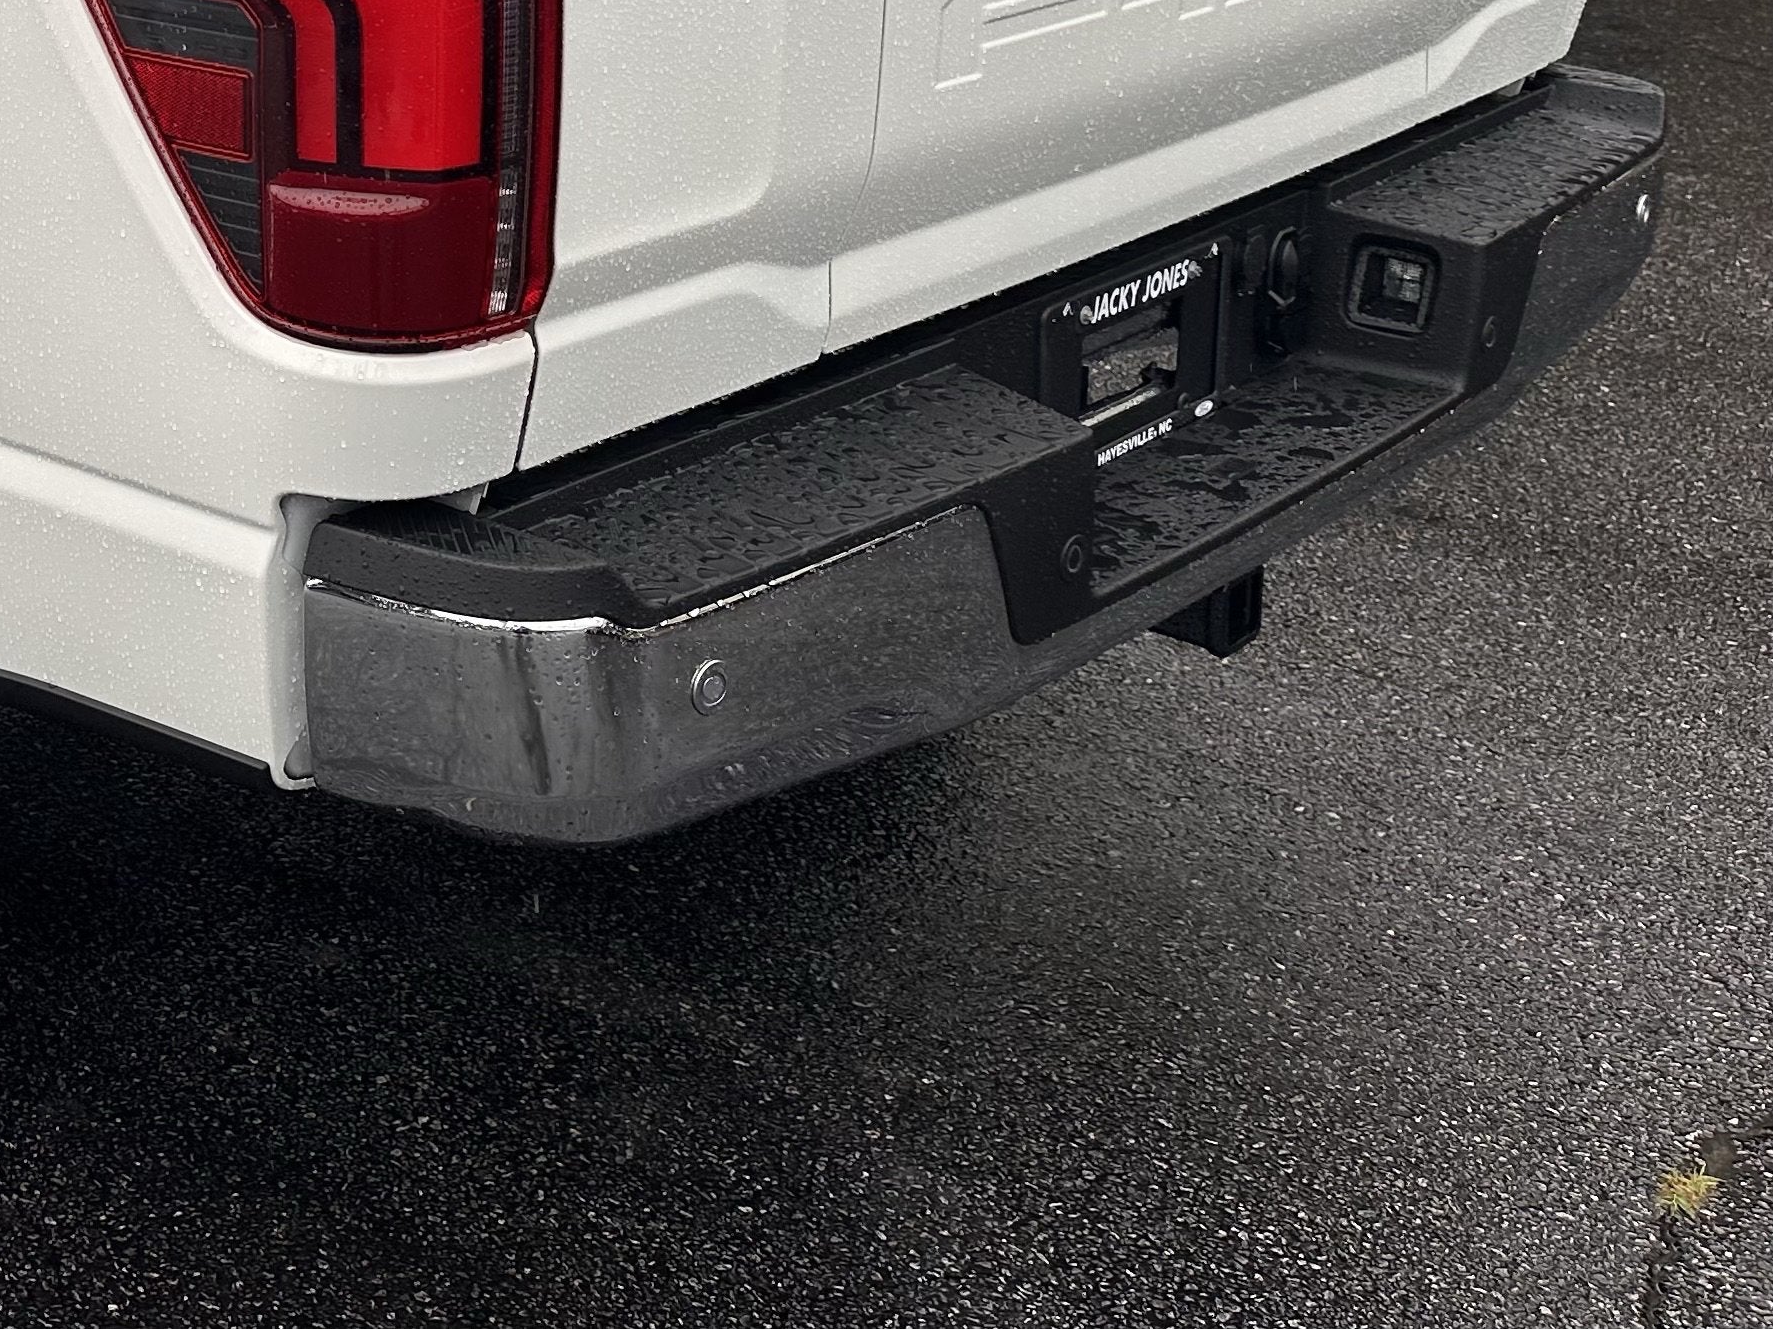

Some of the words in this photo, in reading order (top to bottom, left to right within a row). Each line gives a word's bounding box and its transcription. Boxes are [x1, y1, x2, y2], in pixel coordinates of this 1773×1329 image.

[1091, 280, 1141, 324] JACKY
[1142, 259, 1190, 303] JONES
[1097, 426, 1157, 466] HAYESVILLE,
[1158, 418, 1173, 435] NC
